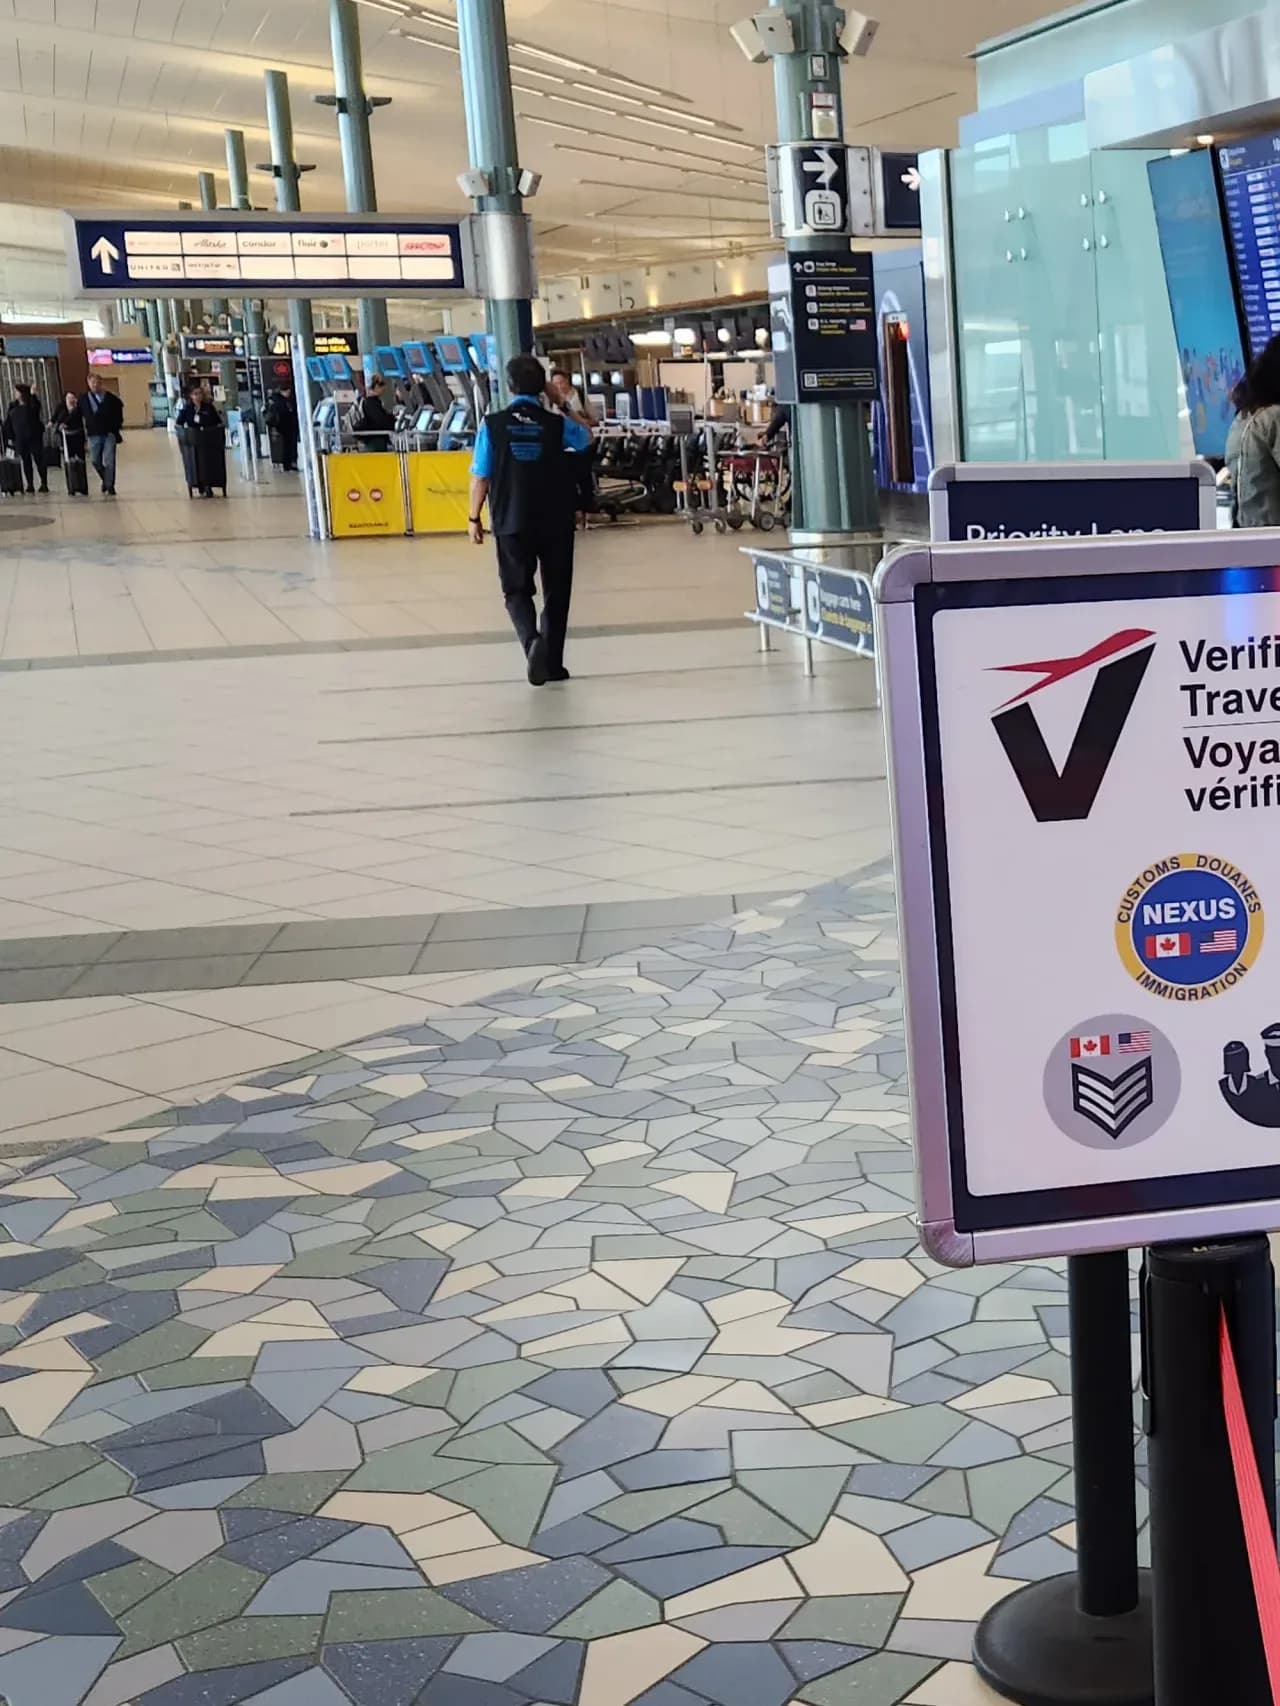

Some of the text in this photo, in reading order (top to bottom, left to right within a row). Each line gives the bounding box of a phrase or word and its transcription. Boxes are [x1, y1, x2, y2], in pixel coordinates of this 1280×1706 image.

[966, 523, 1081, 542] Priorit
[1117, 854, 1261, 923] CUSTOMS DOUANES
[1142, 897, 1237, 926] NEXUS
[1136, 961, 1248, 1001] IMMIGRATION
